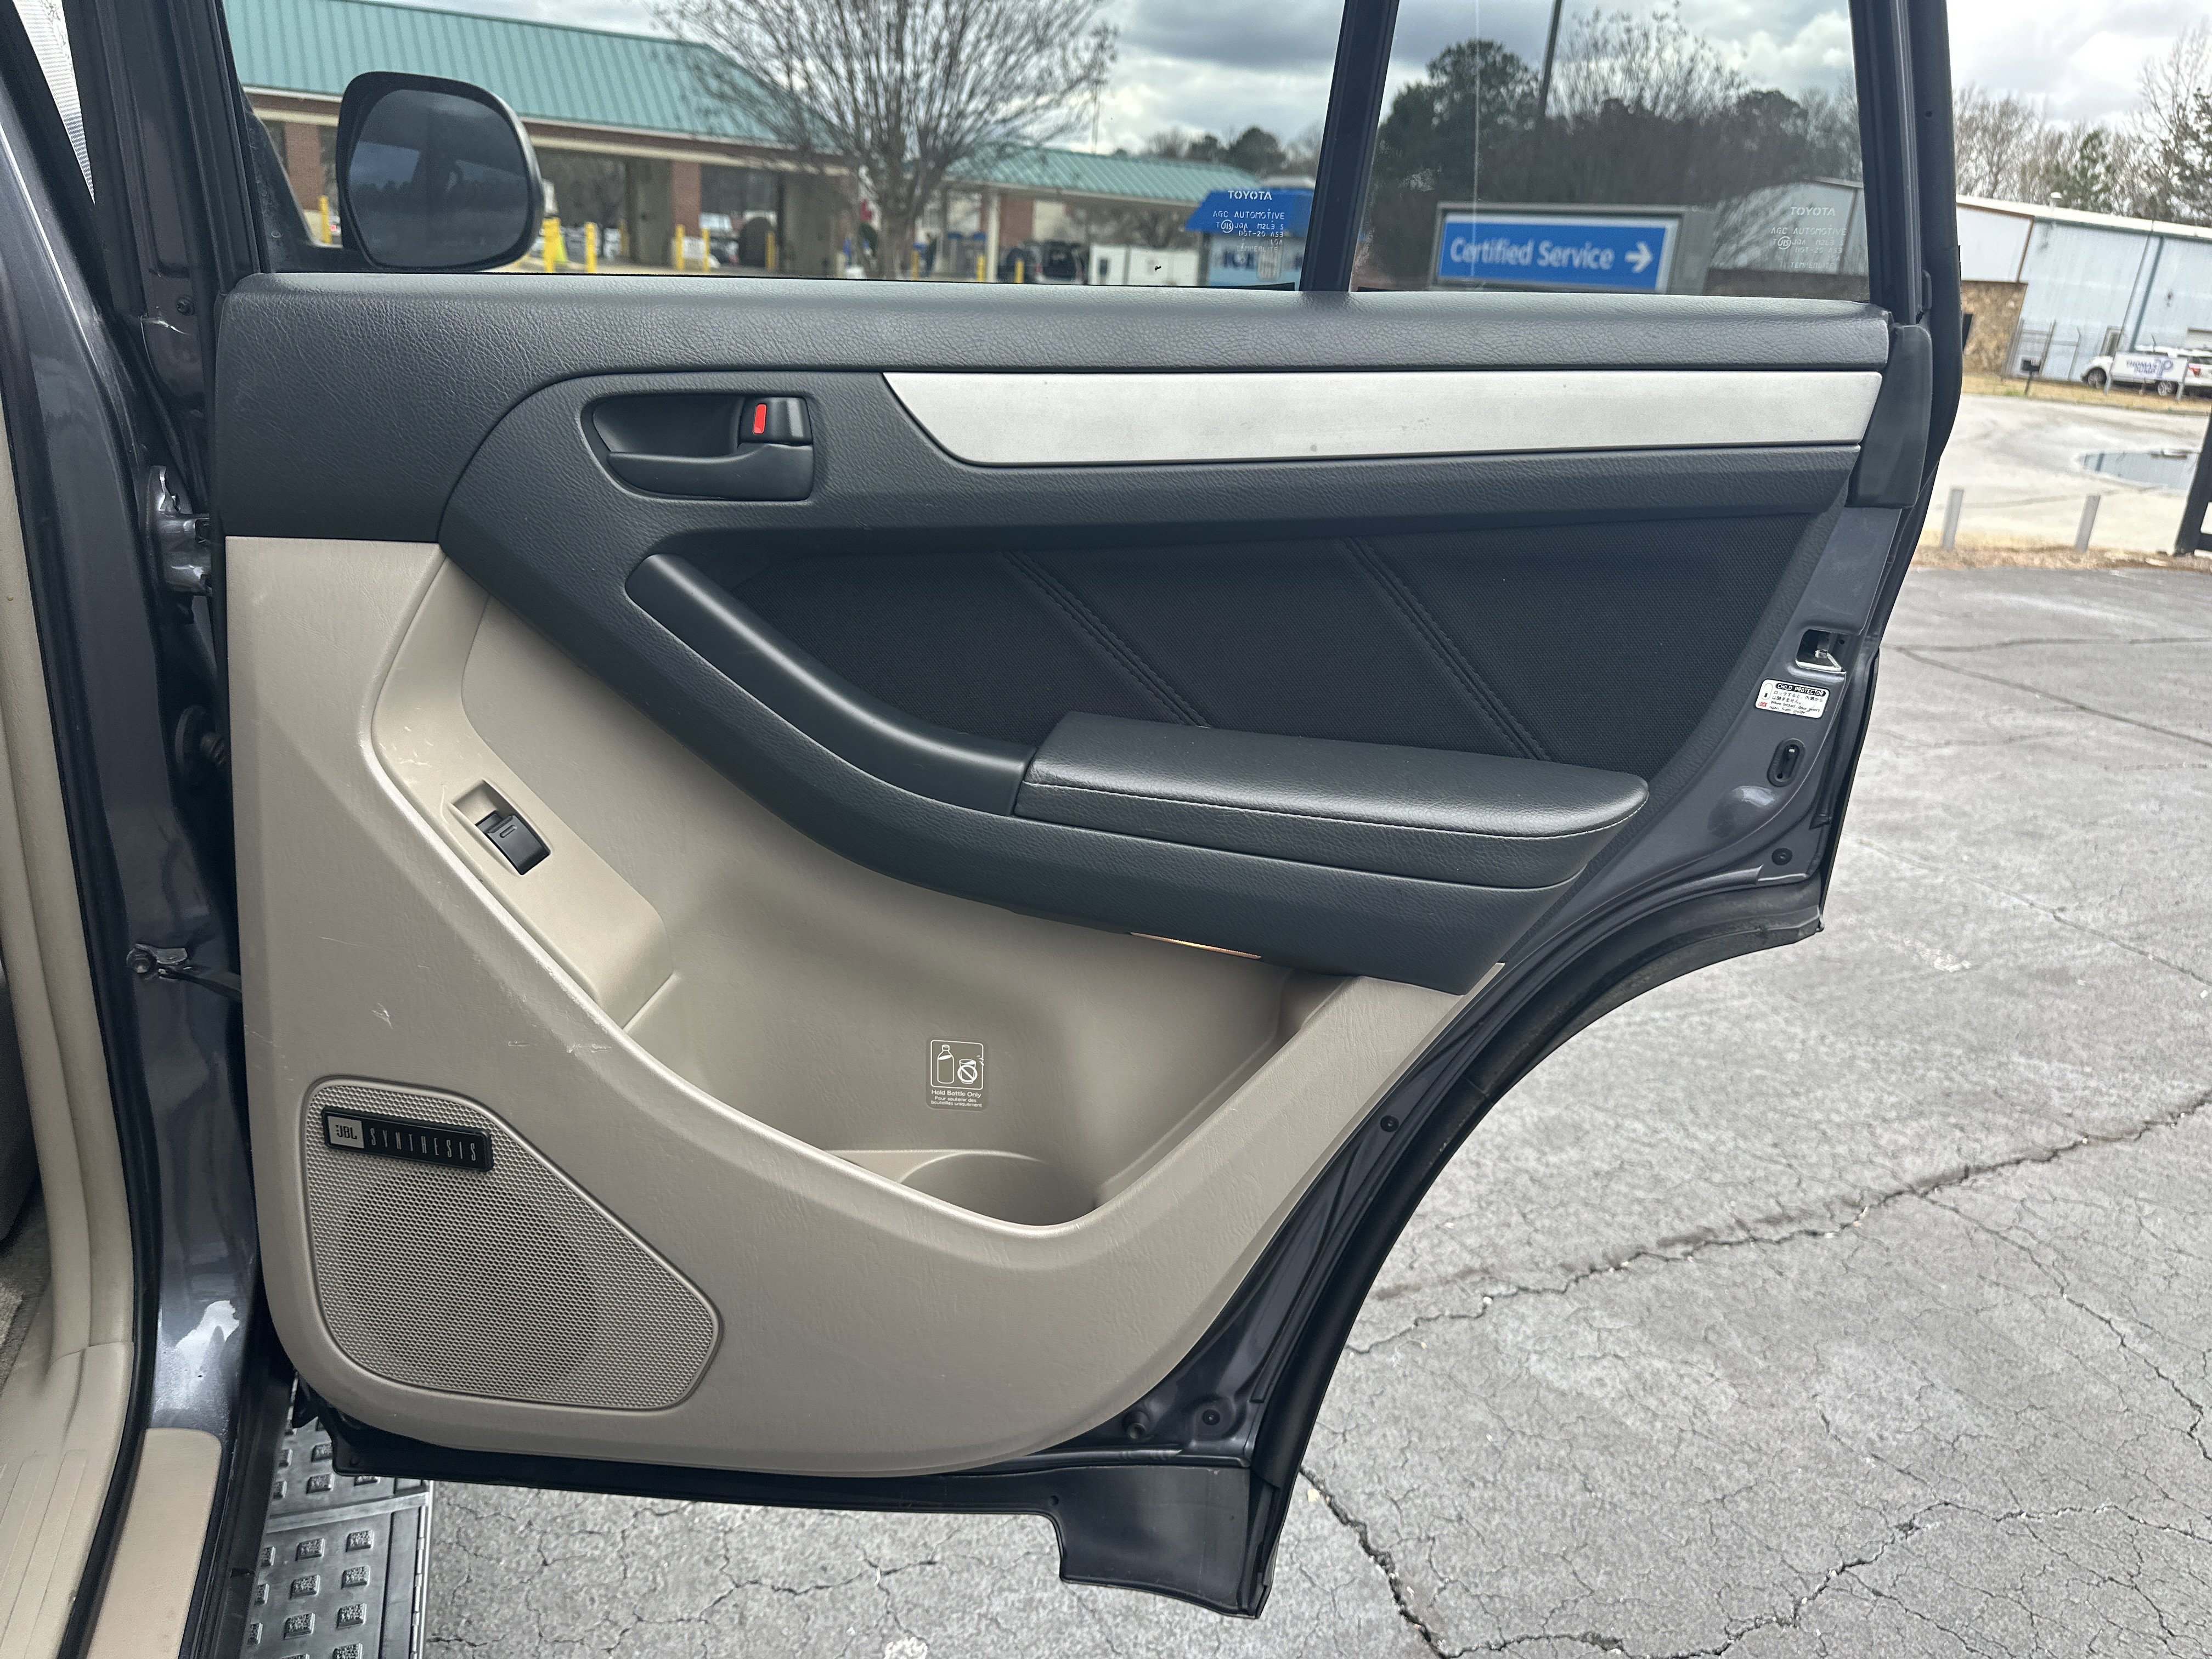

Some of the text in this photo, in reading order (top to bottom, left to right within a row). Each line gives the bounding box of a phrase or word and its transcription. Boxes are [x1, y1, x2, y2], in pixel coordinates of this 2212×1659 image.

[1228, 190, 1272, 200] TOYOTA
[1212, 210, 1285, 220] AGC AUTOMOTIVE
[1790, 206, 1836, 216] TOYOTA
[1450, 236, 1615, 270] Certified Service
[1794, 686, 1824, 696] PROTECTOR
[336, 1125, 476, 1161] JBL SYNTHESIS
